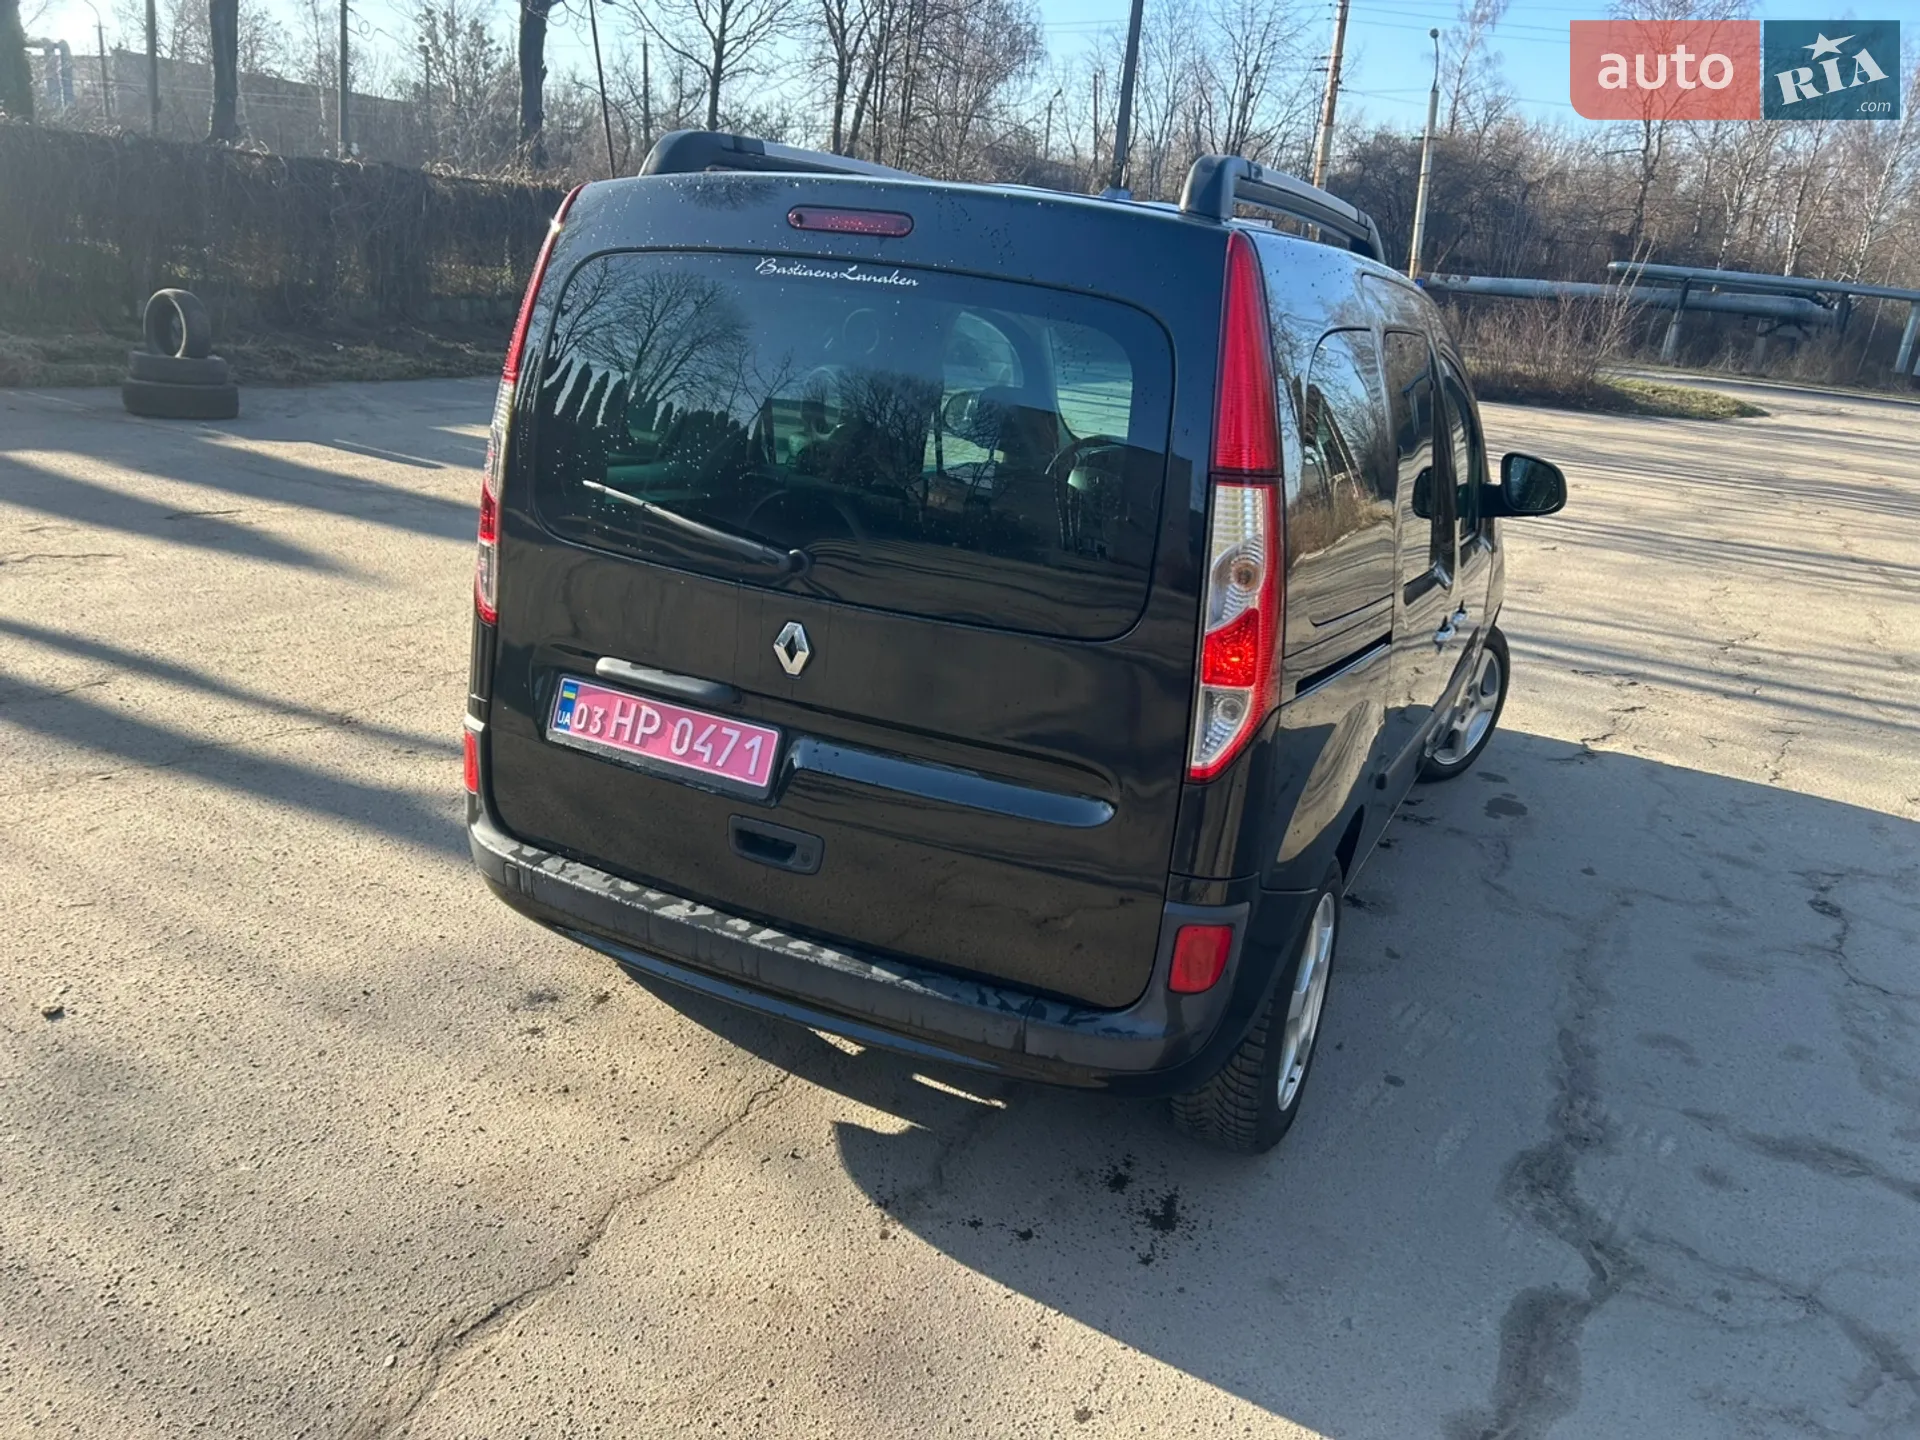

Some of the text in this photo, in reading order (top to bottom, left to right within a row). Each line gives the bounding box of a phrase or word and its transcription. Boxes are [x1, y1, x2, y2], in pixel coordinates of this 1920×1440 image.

[557, 710, 571, 726] UA
[573, 699, 763, 776] 03 HP 0471
